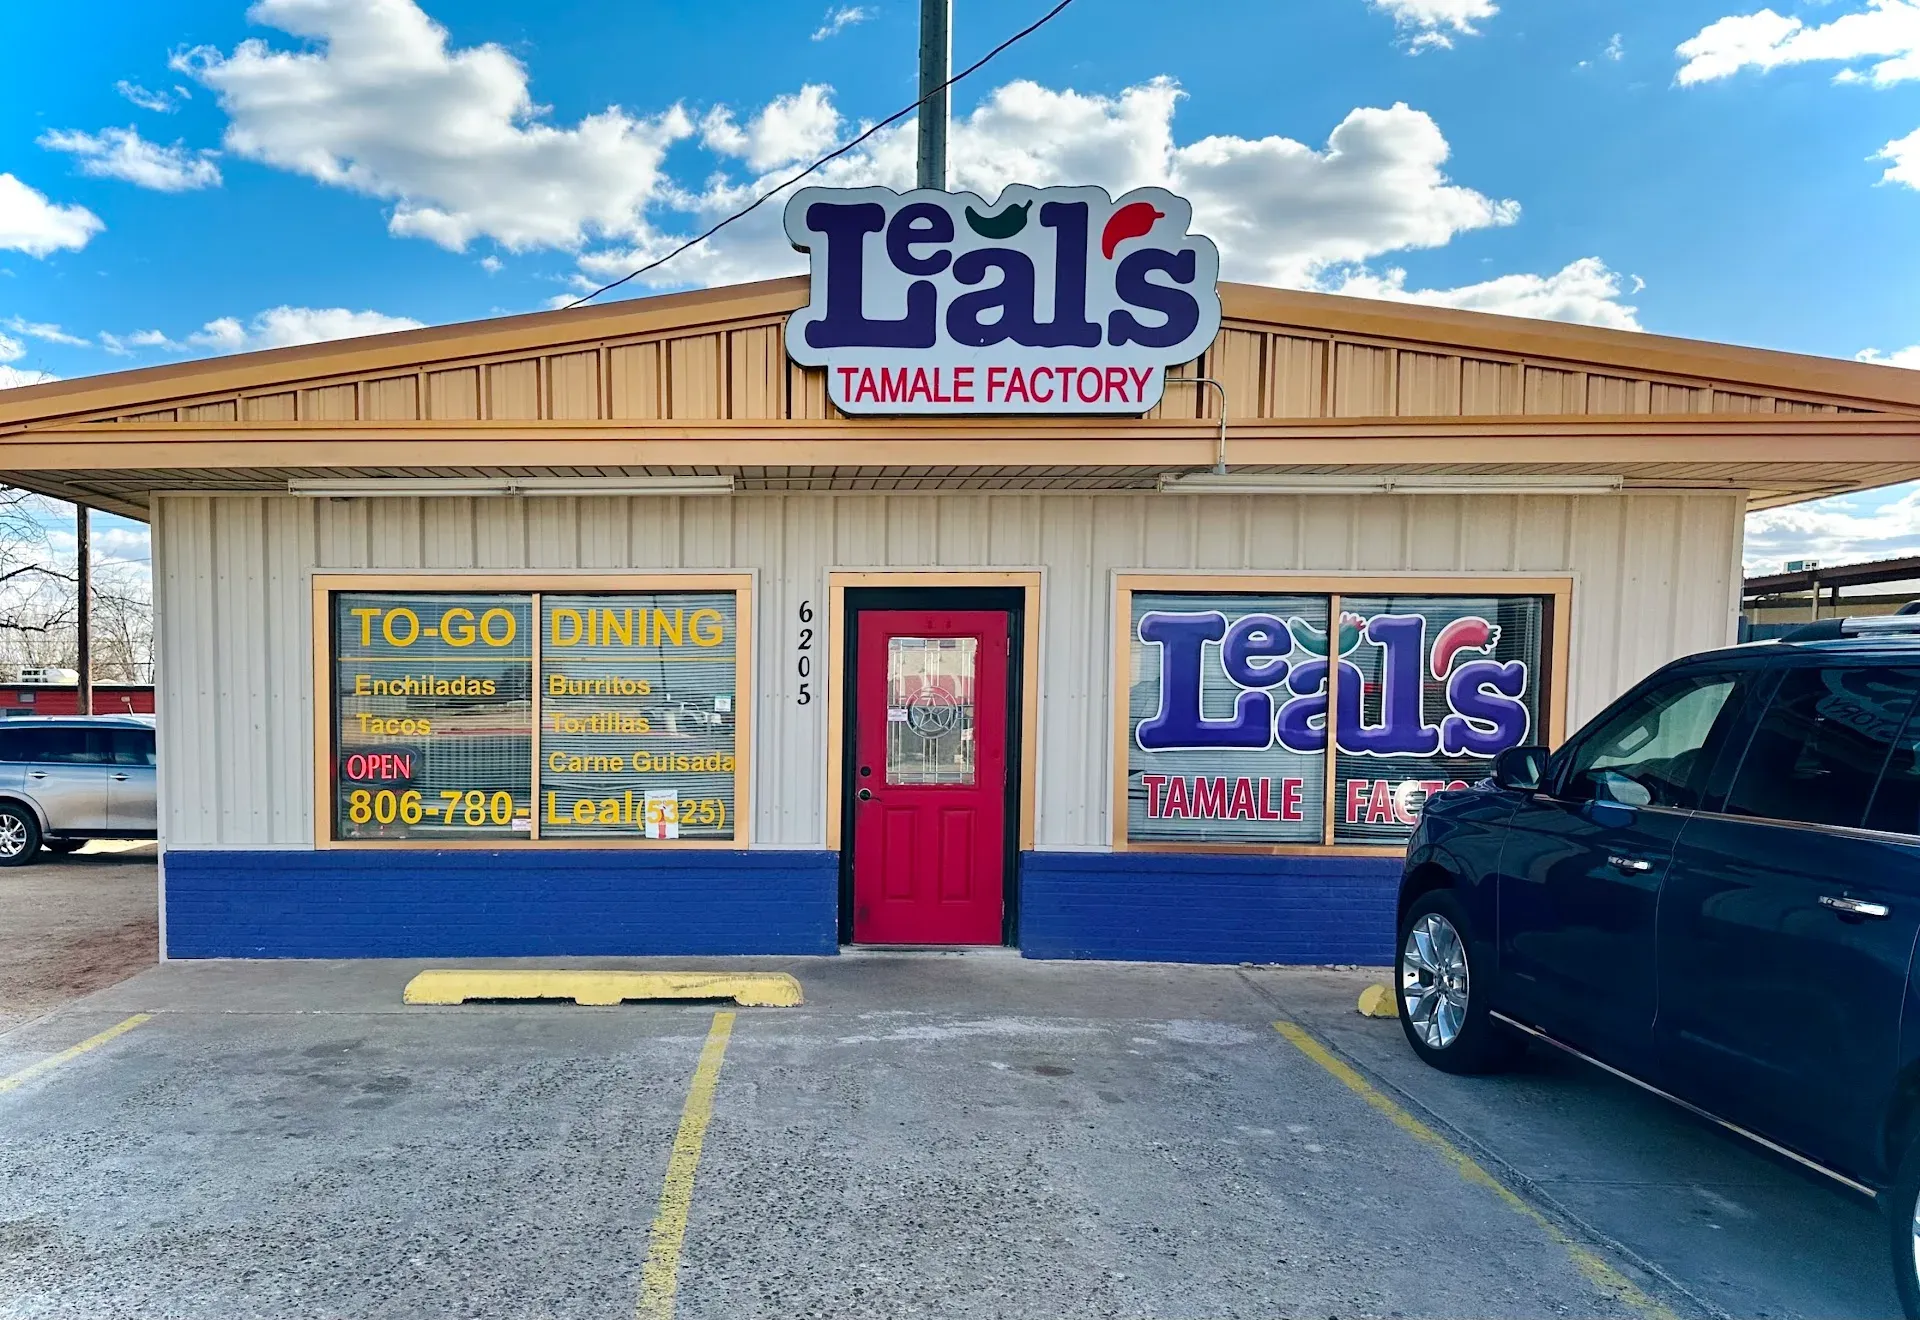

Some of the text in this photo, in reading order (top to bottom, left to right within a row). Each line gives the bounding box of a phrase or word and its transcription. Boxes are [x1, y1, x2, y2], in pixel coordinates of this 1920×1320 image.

[837, 366, 1155, 403] TAMALE FACTORY
[351, 607, 725, 647] TO-GO DINING
[797, 600, 813, 705] 6205
[354, 675, 497, 696] Enchiladas
[549, 674, 651, 696] Burritos
[356, 713, 432, 736] Tacos
[549, 712, 650, 733] Tortillas
[346, 754, 411, 780] OPEN
[549, 751, 736, 772] Carne Guisada
[1142, 775, 1303, 822] TAMALE
